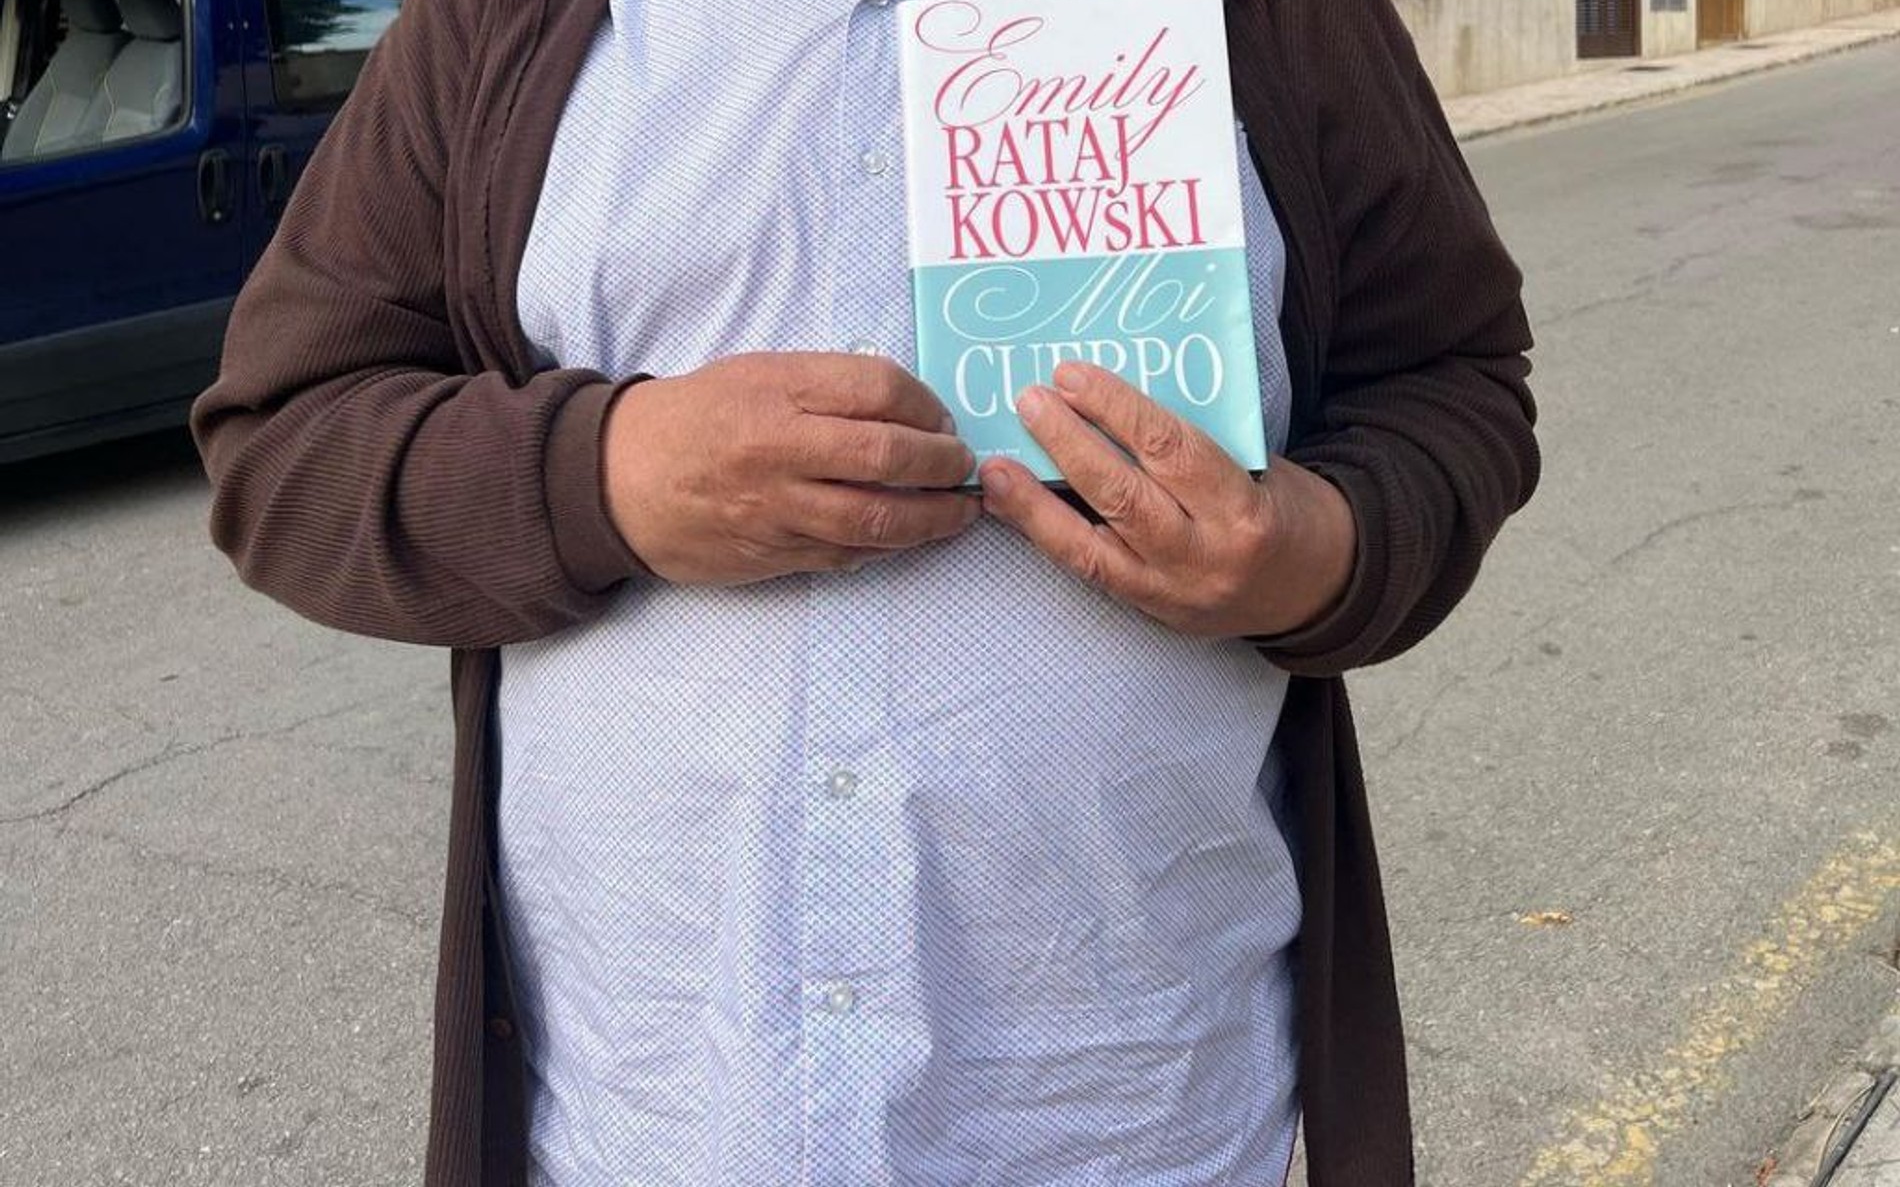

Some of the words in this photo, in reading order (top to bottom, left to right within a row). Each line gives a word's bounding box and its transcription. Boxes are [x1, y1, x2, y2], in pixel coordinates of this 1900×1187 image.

[914, 0, 1206, 161] Emily
[941, 113, 1132, 199] RATAJ
[942, 252, 1216, 342] Mi
